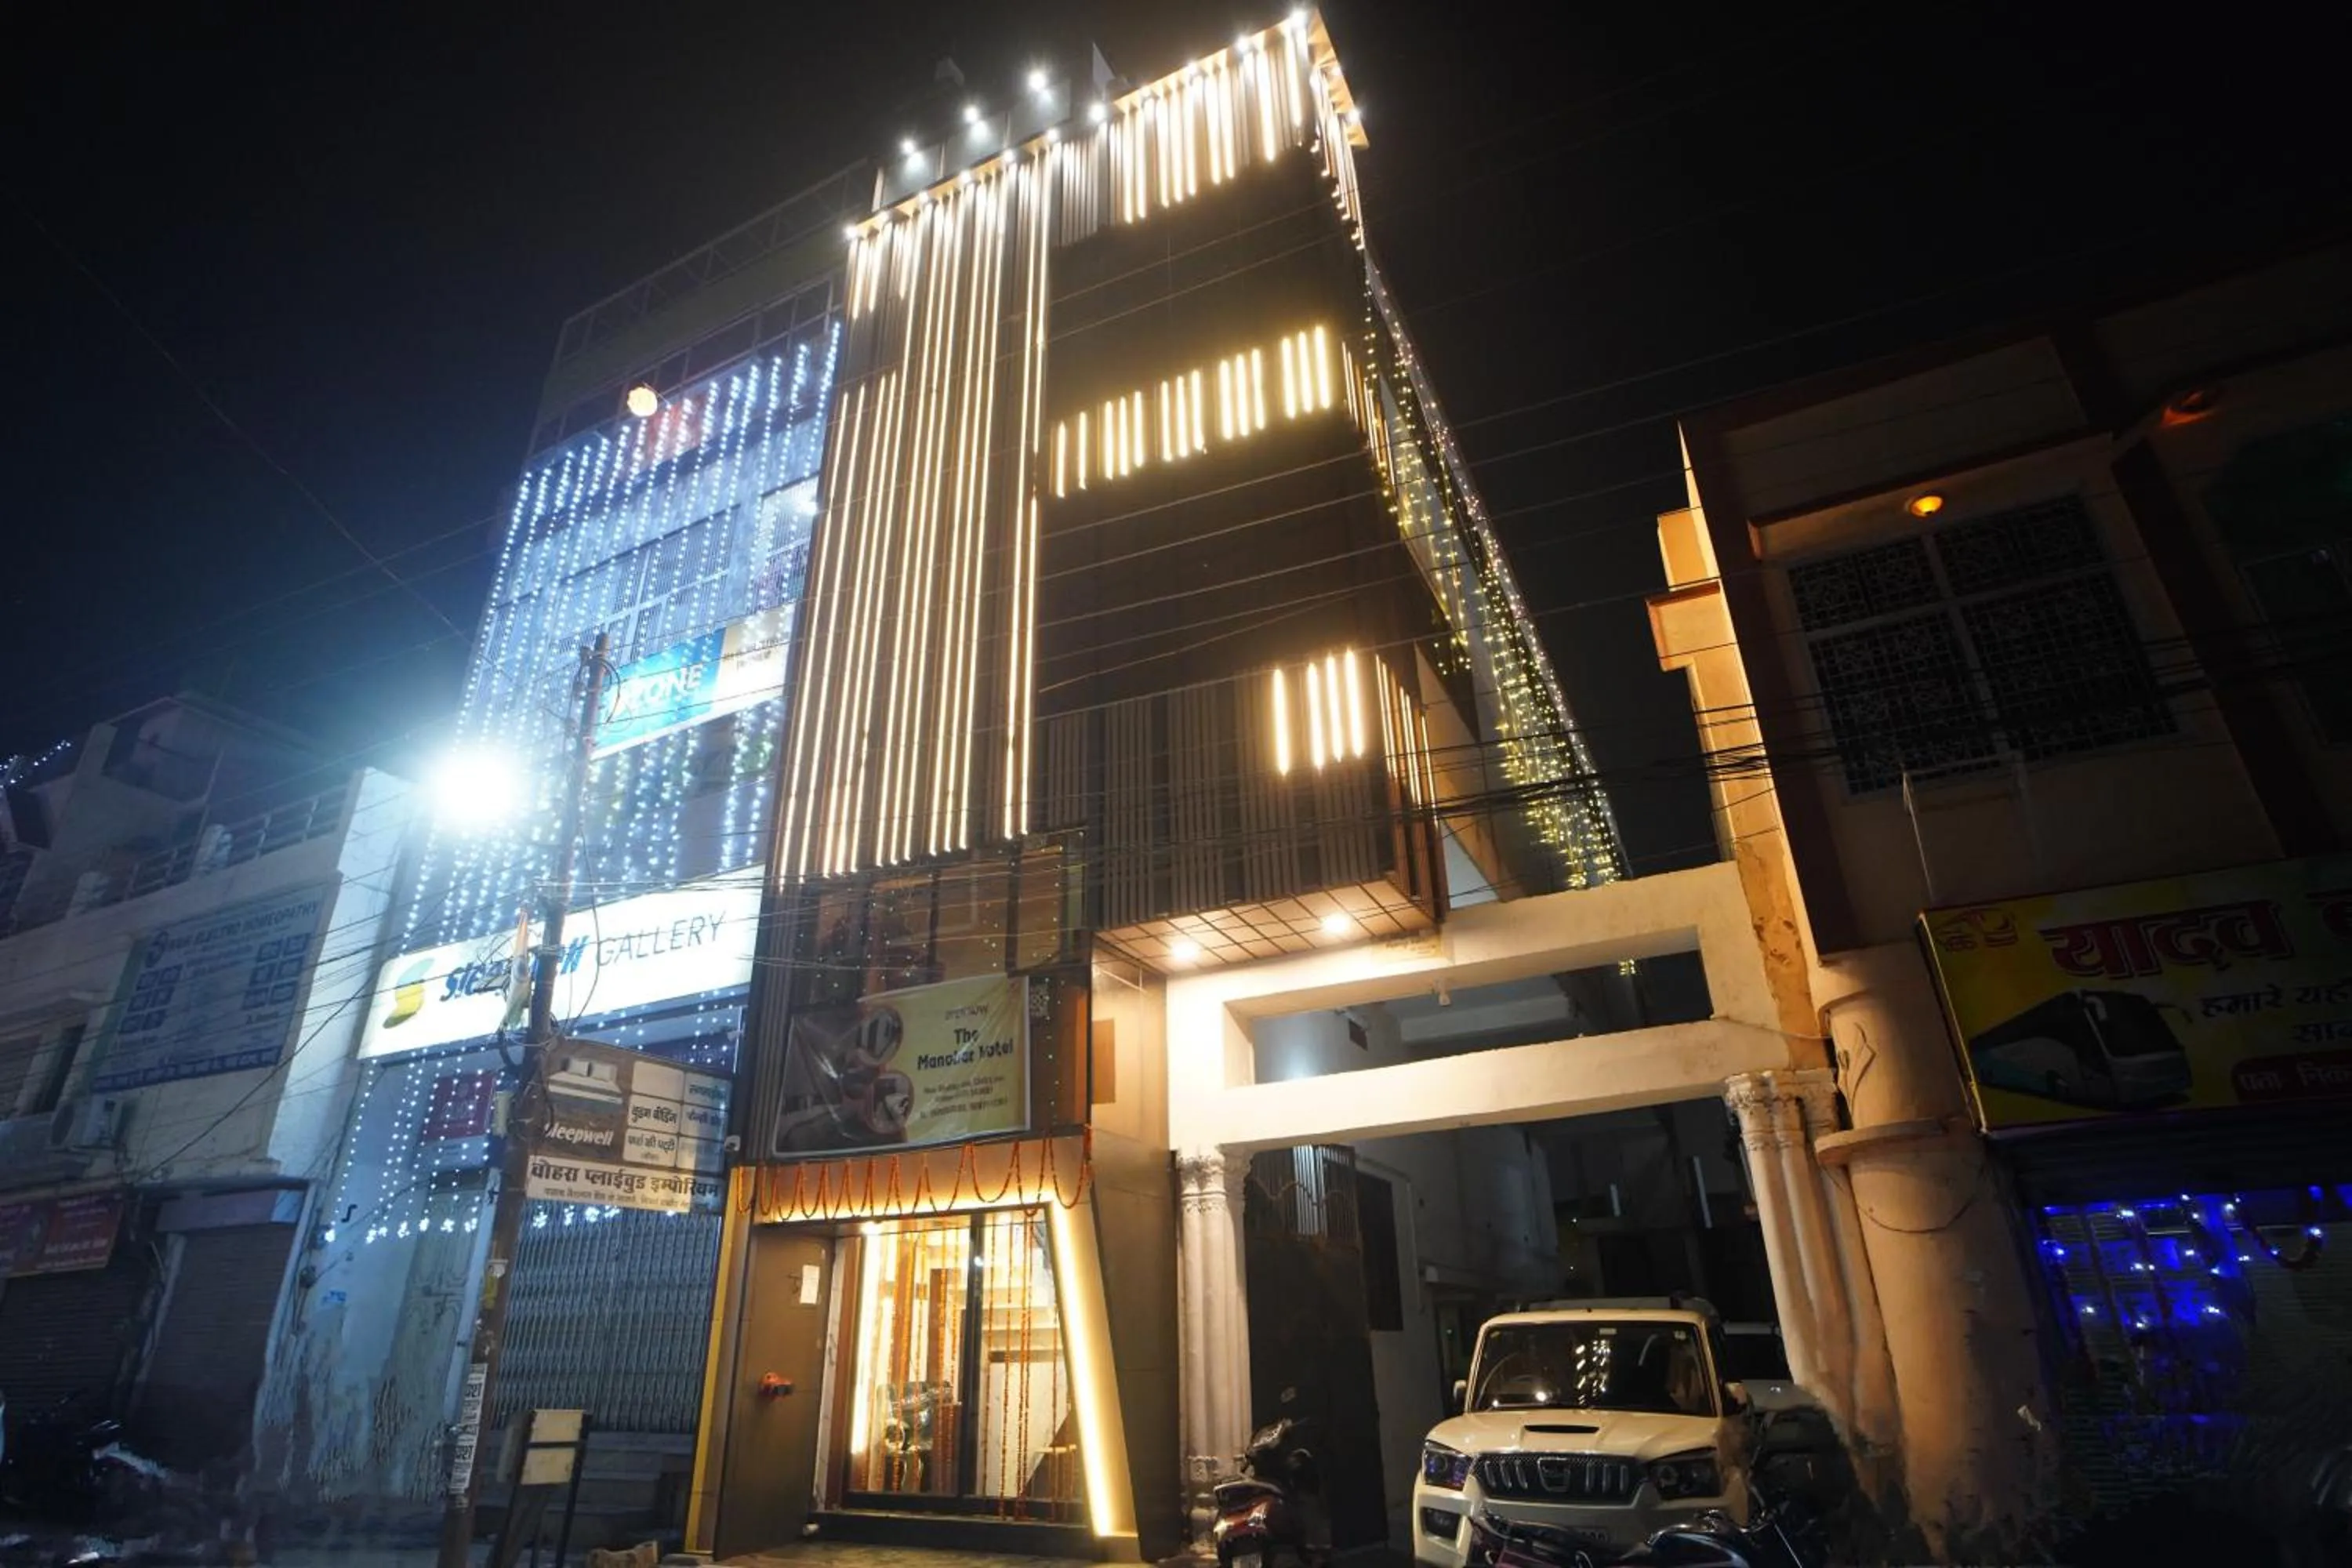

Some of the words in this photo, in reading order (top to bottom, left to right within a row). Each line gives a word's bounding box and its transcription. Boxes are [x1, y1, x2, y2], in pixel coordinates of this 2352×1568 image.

[597, 912, 726, 967] GALLERY
[2037, 898, 2295, 979] यादव
[2198, 983, 2284, 1019] हमारे
[953, 1028, 980, 1044] The
[585, 1167, 648, 1192] प्लाईवुड
